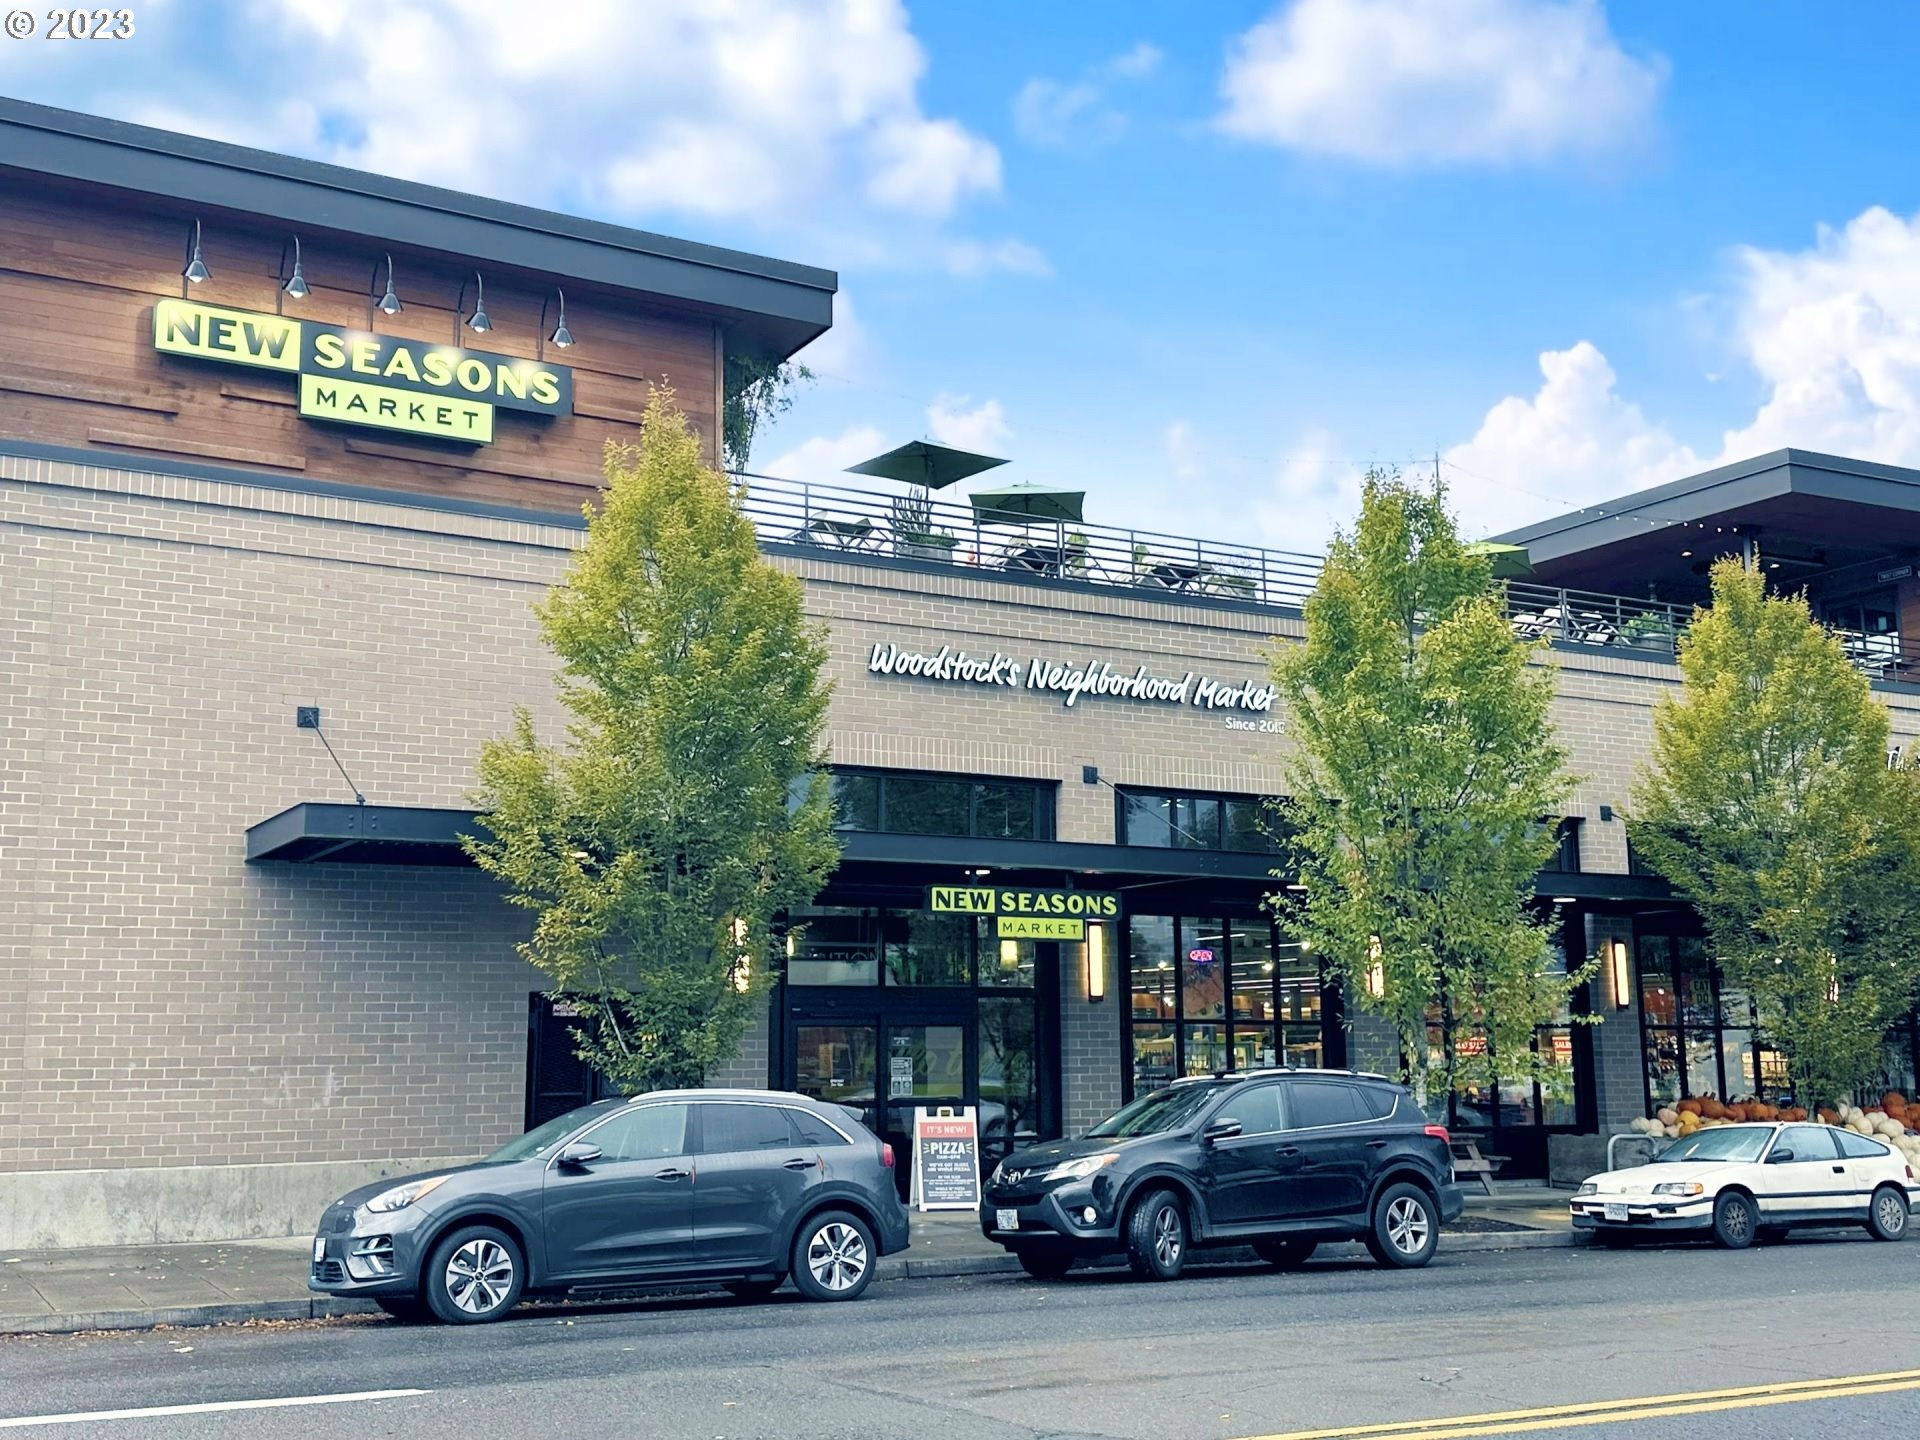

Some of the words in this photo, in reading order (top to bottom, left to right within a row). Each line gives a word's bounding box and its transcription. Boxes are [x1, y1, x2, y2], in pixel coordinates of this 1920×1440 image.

[166, 311, 290, 359] NEW
[313, 332, 561, 405] SEASONS
[316, 387, 479, 429] MARKET
[869, 643, 1021, 686] Woodstock's
[1026, 658, 1194, 707] Neighborhood
[1193, 676, 1280, 712] Market
[1225, 716, 1256, 731] Since
[935, 890, 991, 910] NEW
[1001, 892, 1117, 916] SEASONS
[1002, 922, 1079, 935] MARKET
[1190, 950, 1213, 961] OPEN
[927, 1126, 942, 1134] IT'S
[944, 1126, 966, 1134] NEW!
[930, 1142, 965, 1154] PIZZA
